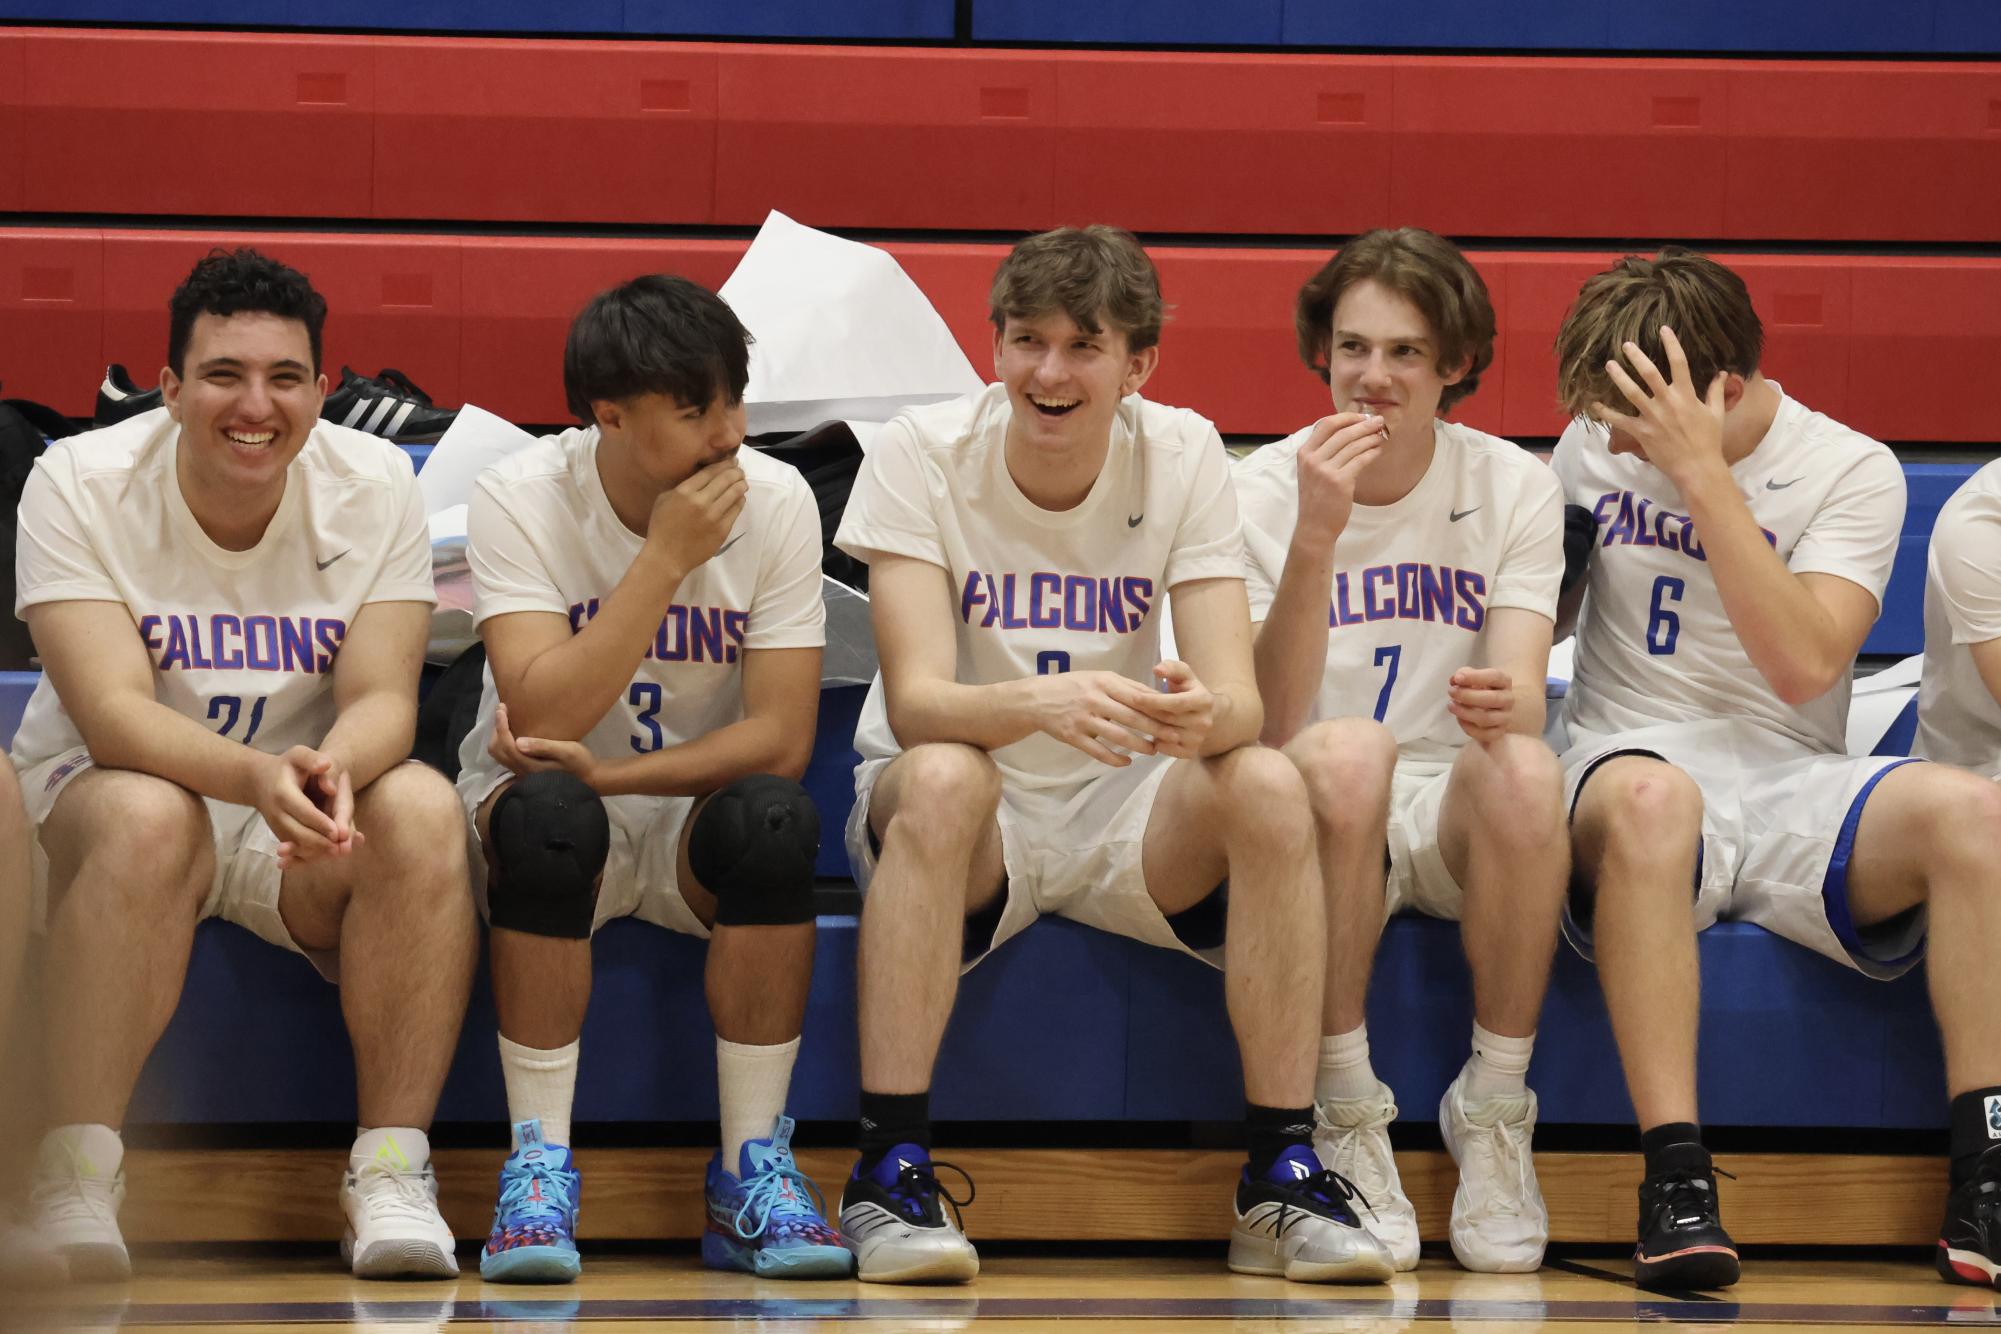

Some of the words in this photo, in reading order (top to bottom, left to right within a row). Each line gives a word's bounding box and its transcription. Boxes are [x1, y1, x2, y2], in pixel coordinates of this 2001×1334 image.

[1593, 490, 1777, 562] FALCO
[961, 570, 1153, 634] FALCONS
[1328, 562, 1486, 633] LCONS
[1646, 575, 1685, 655] 6
[139, 613, 347, 674] FALCONS
[629, 682, 663, 754] 3
[1373, 644, 1402, 723] 7
